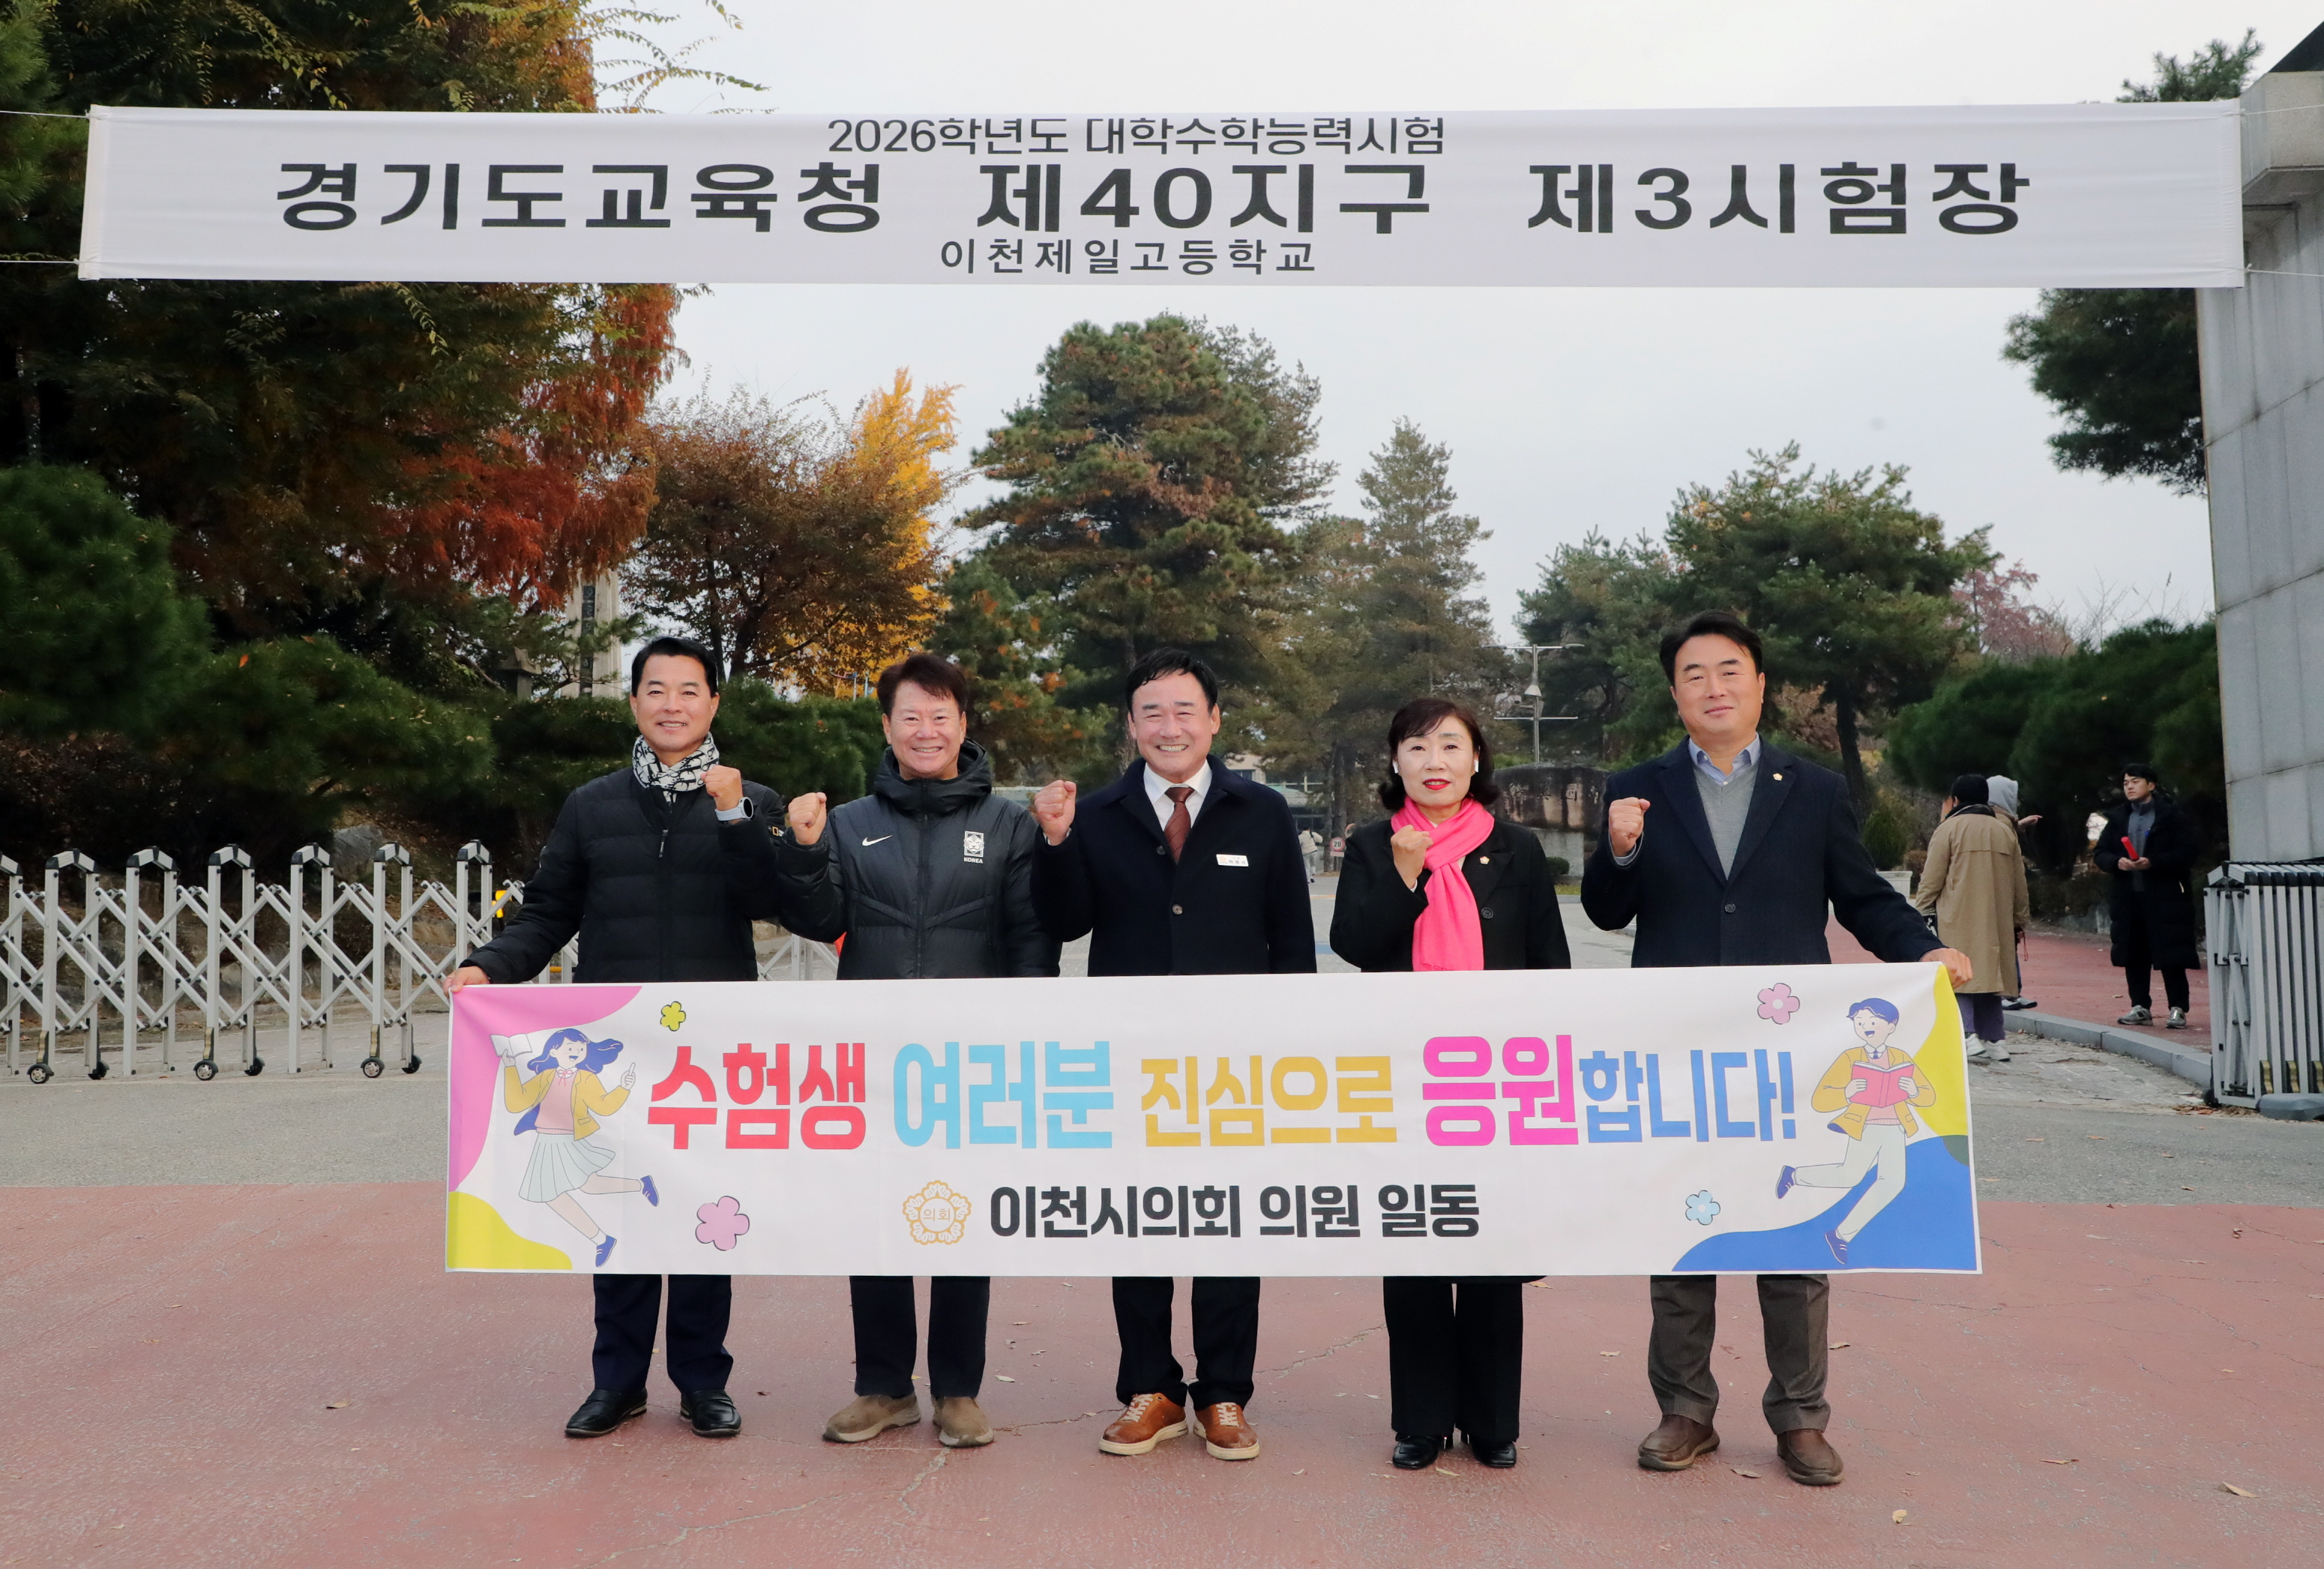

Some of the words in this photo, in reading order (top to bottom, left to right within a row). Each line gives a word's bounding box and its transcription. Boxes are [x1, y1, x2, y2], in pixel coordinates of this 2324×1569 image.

[829, 118, 1068, 155] 2026학년도
[1087, 118, 1444, 155] 대학수학능력시험
[277, 163, 880, 234] 경기도교육청
[978, 164, 1430, 235] 제40지구
[1529, 162, 2031, 235] 제3시험장
[942, 239, 1316, 276] 이천제일고등학교
[648, 1042, 867, 1151] 수험생
[894, 1041, 1114, 1149] 여러분
[1142, 1055, 1397, 1148] 진심으로
[1423, 1035, 1796, 1148] 응원합니다!
[923, 1208, 951, 1222] 의회
[991, 1186, 1241, 1239] 이천시의회
[1260, 1185, 1361, 1238] 의원
[1379, 1184, 1480, 1238] 일동
